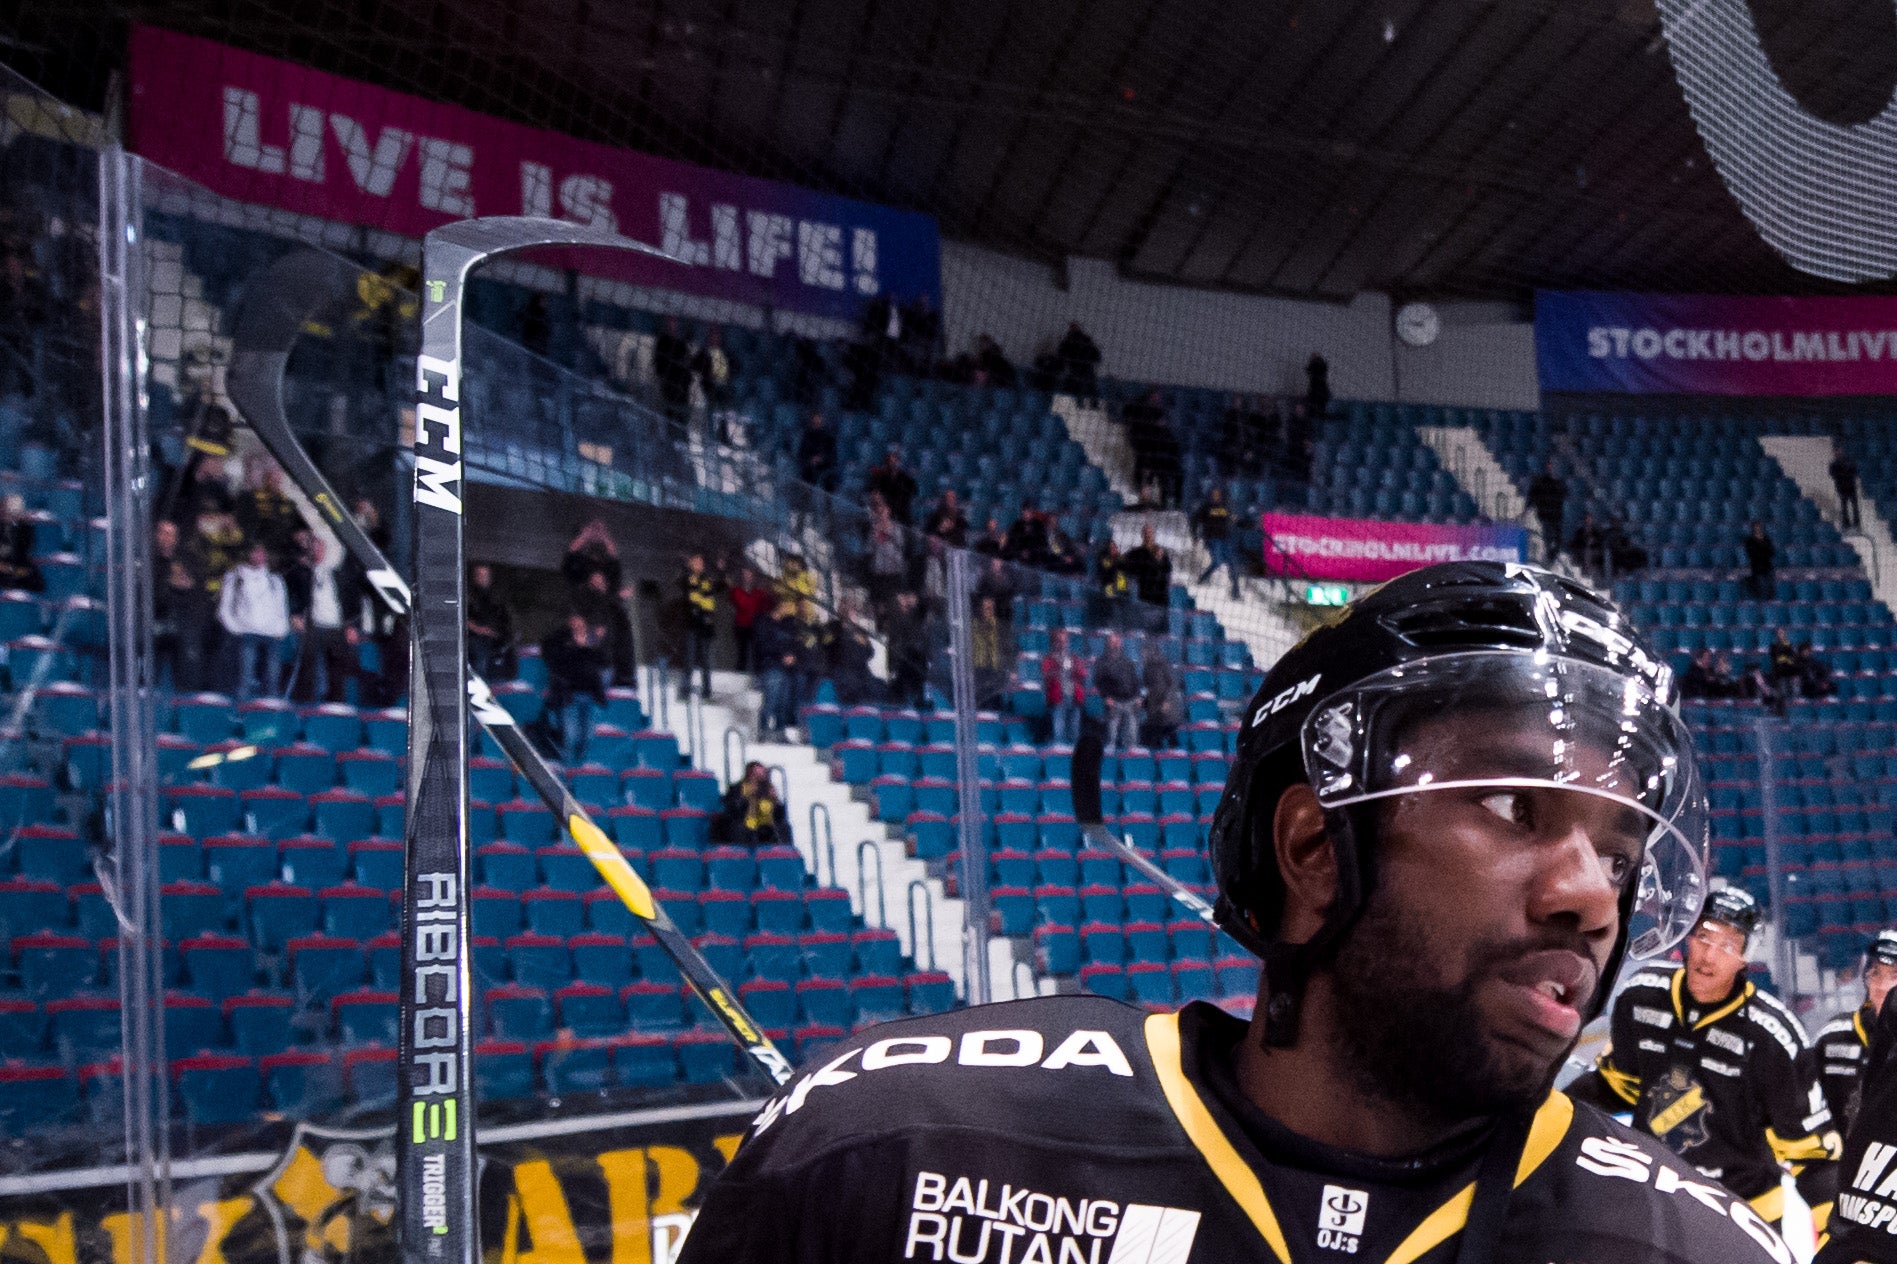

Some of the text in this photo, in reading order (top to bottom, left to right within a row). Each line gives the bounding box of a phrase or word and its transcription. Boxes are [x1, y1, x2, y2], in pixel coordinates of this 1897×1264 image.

[222, 86, 880, 296] LIVE IS LIFE!
[414, 355, 464, 516] CCM
[1251, 673, 1323, 728] CCM
[422, 1153, 447, 1228] TRIGGER
[913, 1171, 1119, 1238] BALKONG
